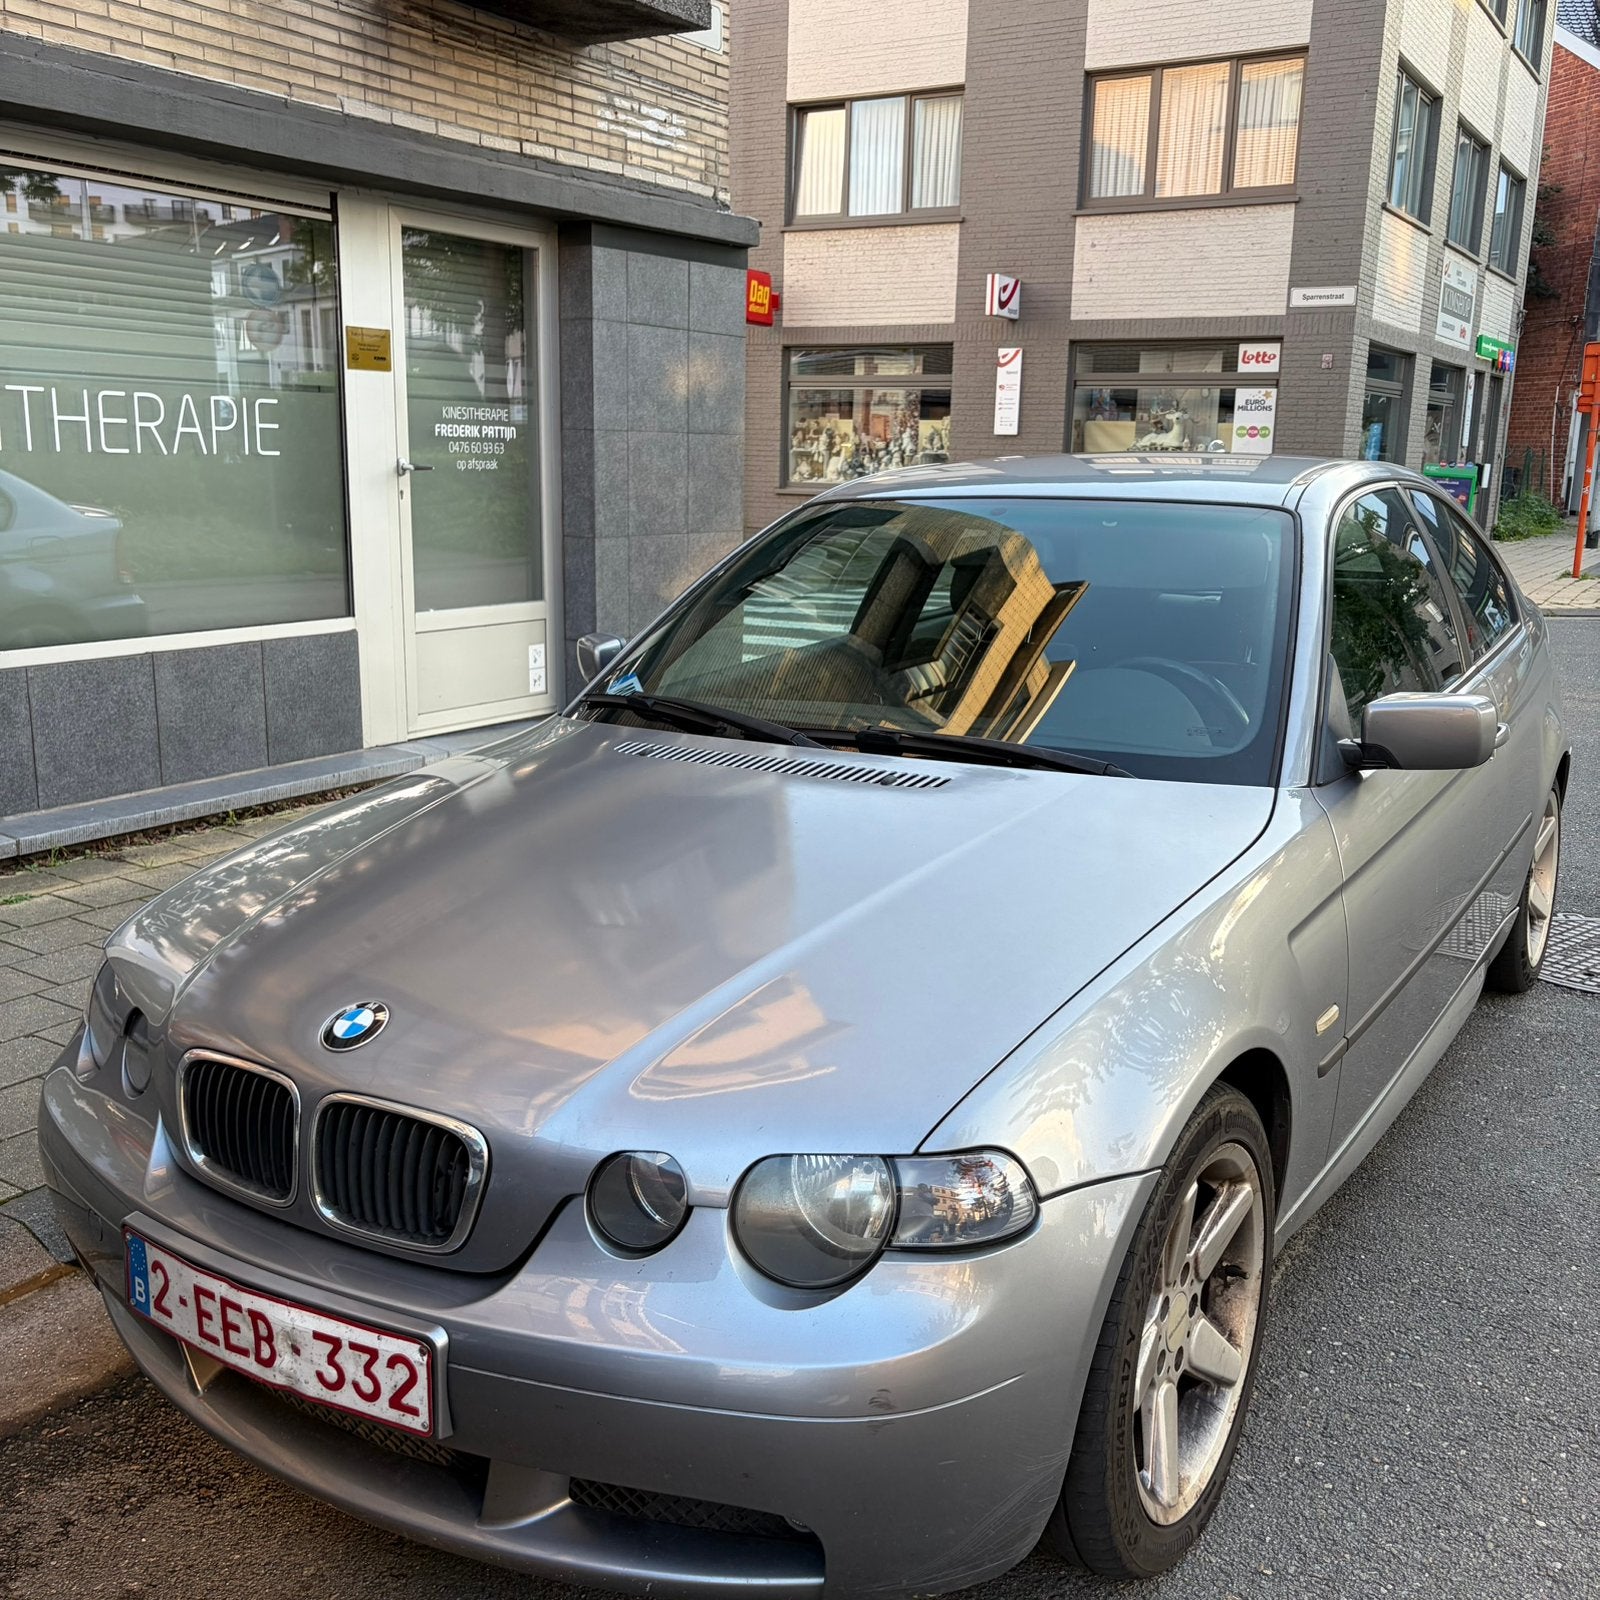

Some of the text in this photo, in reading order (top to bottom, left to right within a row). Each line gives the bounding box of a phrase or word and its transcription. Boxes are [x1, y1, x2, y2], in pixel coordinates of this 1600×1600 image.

[750, 280, 770, 314] Dag
[1302, 293, 1345, 301] Sparrenstraat
[1241, 350, 1277, 364] Lotto
[0, 384, 280, 456] THERAPIE
[442, 406, 509, 422] KINESITHERAPIE
[434, 423, 480, 438] FREDERIK
[448, 441, 505, 455] 0476 60 93 63
[456, 458, 499, 471] op afspraak
[134, 1275, 146, 1303] B
[150, 1259, 421, 1418] 2-EEB-332
[1121, 1358, 1131, 1385] 17
[1119, 1390, 1128, 1408] R
